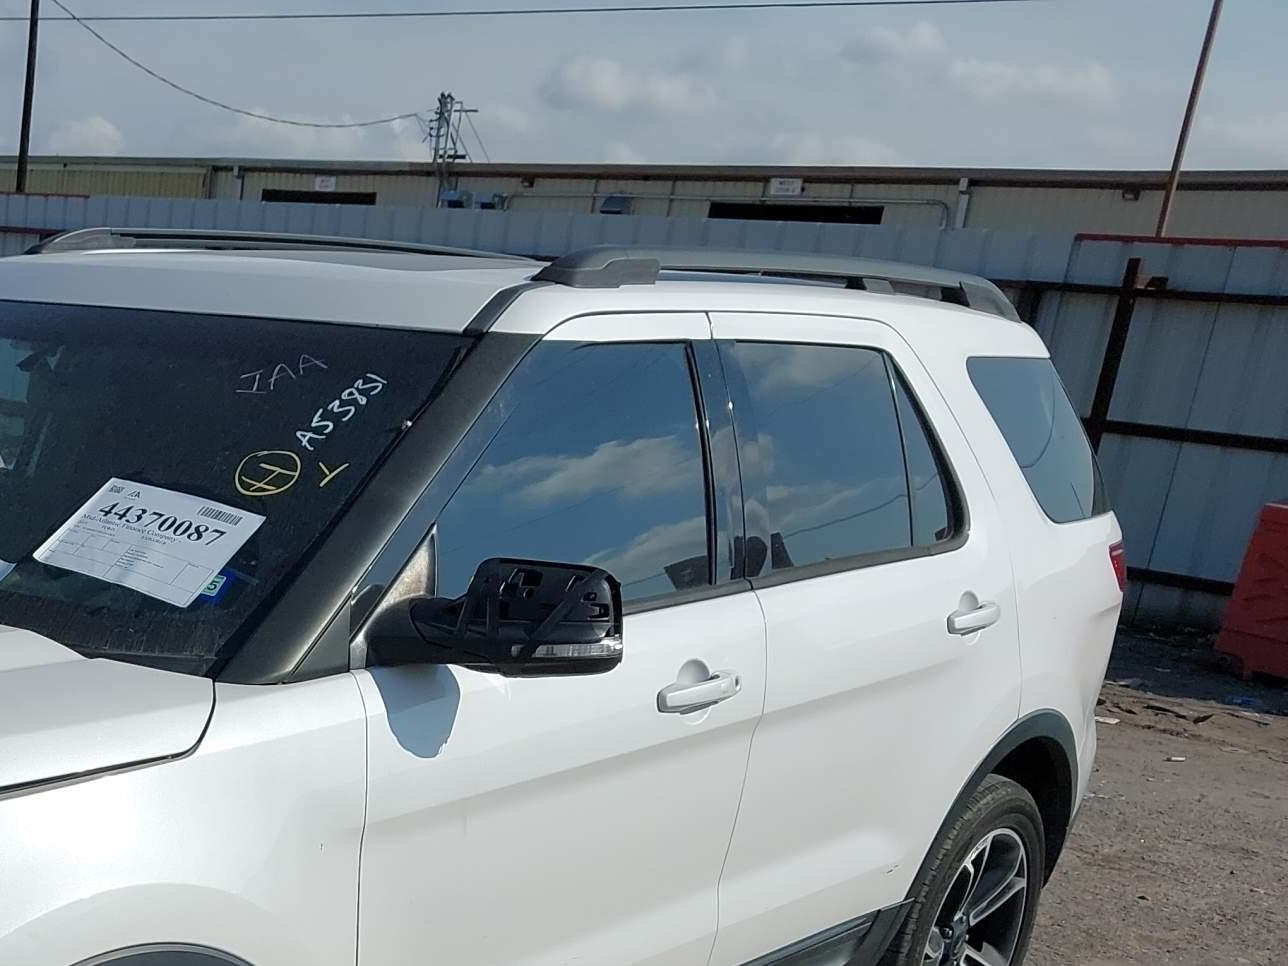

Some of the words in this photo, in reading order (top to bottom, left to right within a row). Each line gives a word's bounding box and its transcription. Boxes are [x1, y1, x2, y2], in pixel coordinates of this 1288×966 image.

[235, 354, 328, 394] IAA
[296, 373, 388, 451] A53831
[81, 513, 120, 528] Mid-Atlantic
[121, 523, 148, 535] Finance
[147, 529, 177, 543] Company
[98, 502, 227, 546] 44370087
